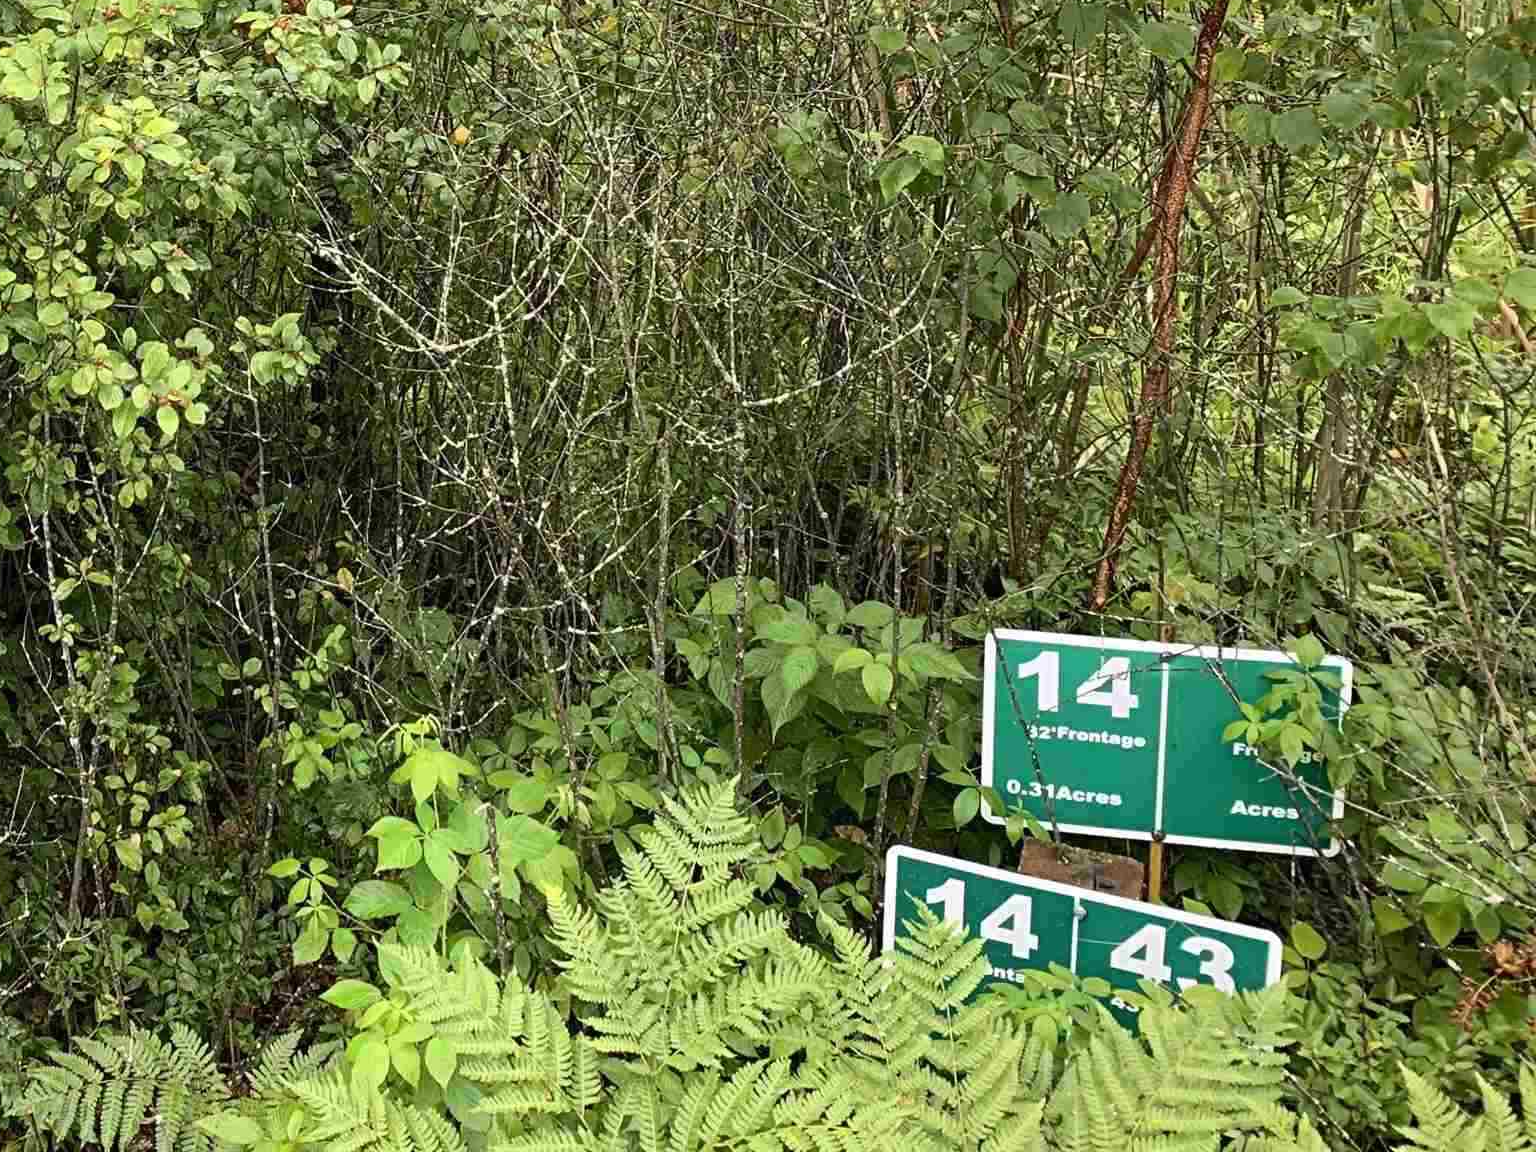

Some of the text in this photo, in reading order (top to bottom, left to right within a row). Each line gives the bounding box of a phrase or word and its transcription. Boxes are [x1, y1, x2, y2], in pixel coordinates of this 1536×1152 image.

[1018, 650, 1139, 718] 14
[1229, 799, 1300, 820] Acres
[925, 877, 1040, 960] 14
[1109, 922, 1236, 999] 43
